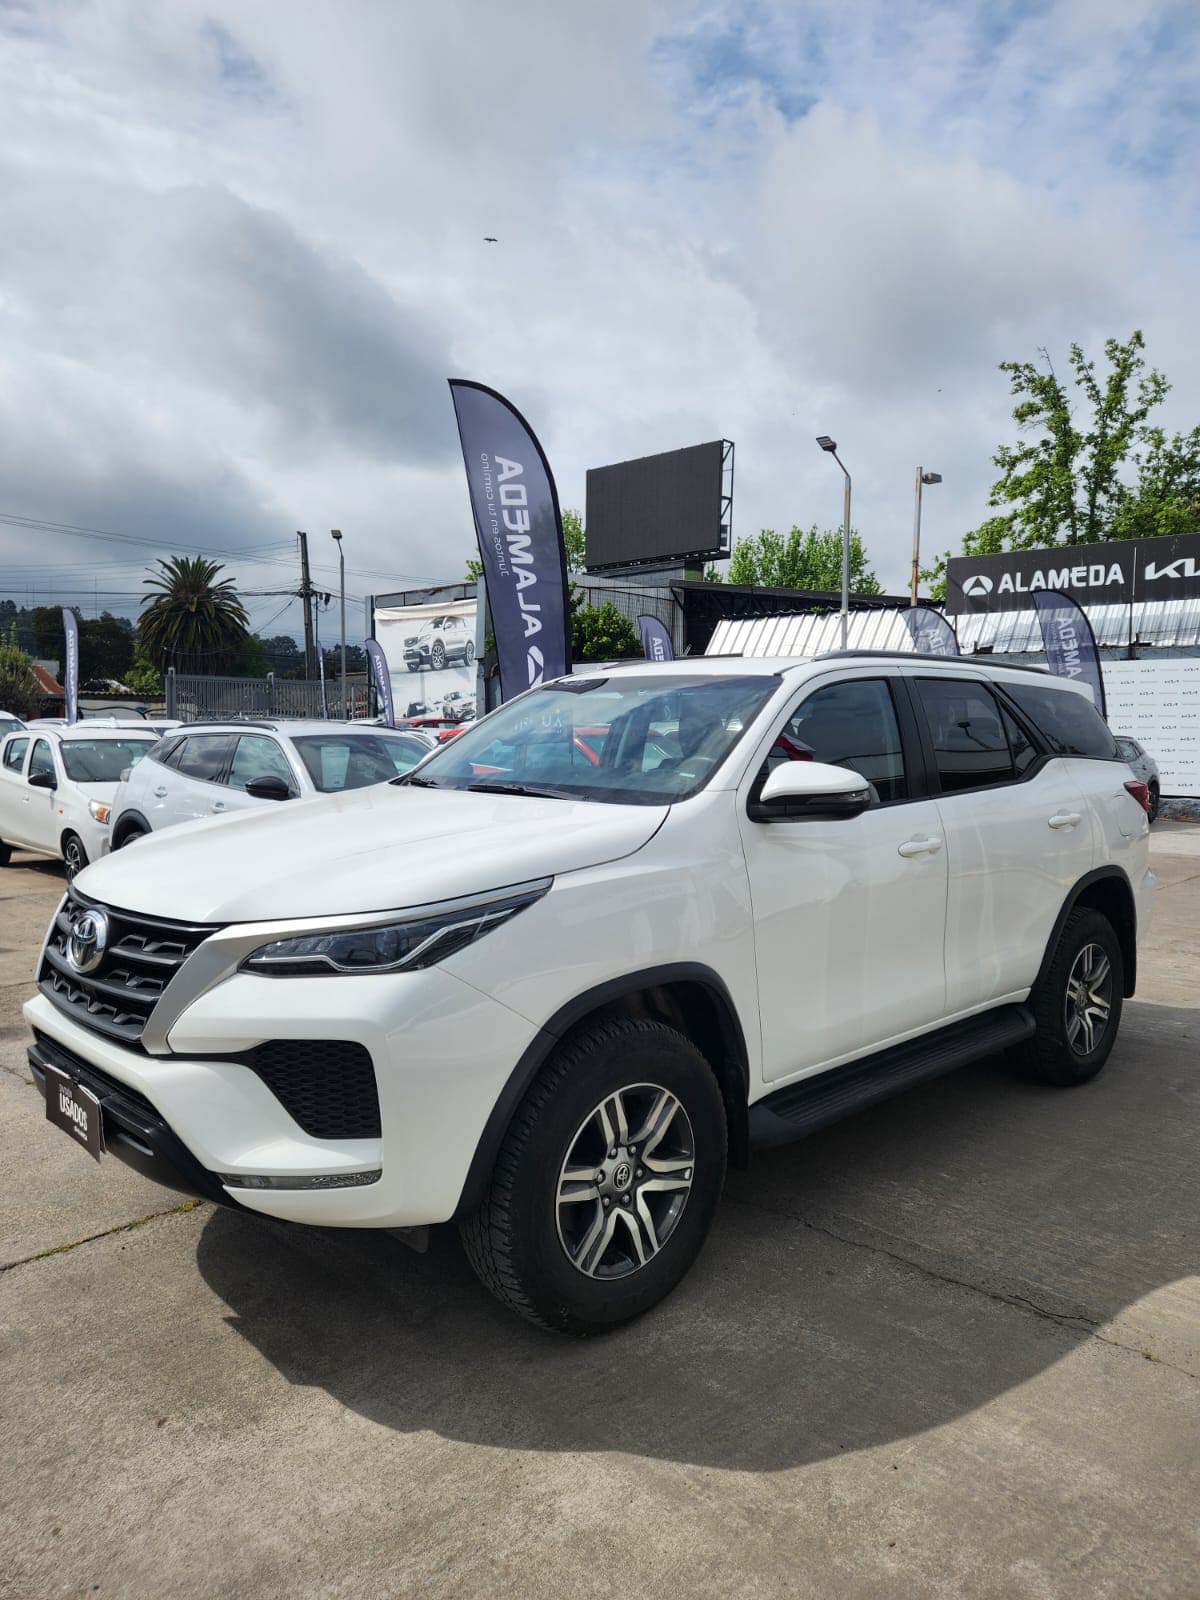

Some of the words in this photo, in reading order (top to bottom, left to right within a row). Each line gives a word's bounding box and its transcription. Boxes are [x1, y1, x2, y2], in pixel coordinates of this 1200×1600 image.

[998, 562, 1125, 594] ALAMEDA
[1145, 558, 1200, 580] KI
[59, 1092, 88, 1132] USADOS
